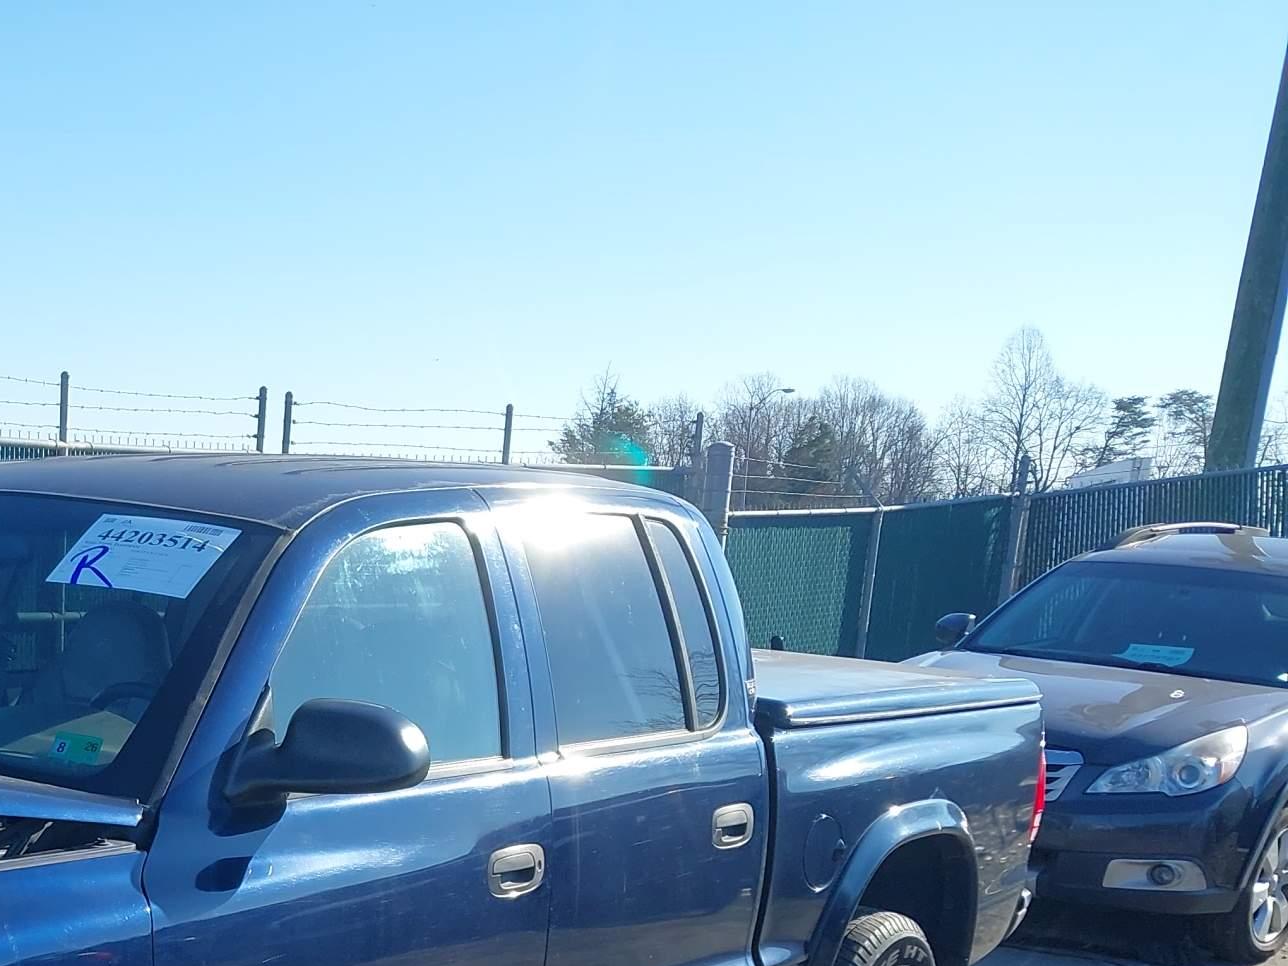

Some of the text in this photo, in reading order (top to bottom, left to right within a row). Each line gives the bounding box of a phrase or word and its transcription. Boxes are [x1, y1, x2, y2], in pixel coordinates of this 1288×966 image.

[98, 528, 210, 553] 44203514
[70, 545, 112, 588] R
[56, 741, 66, 753] 8
